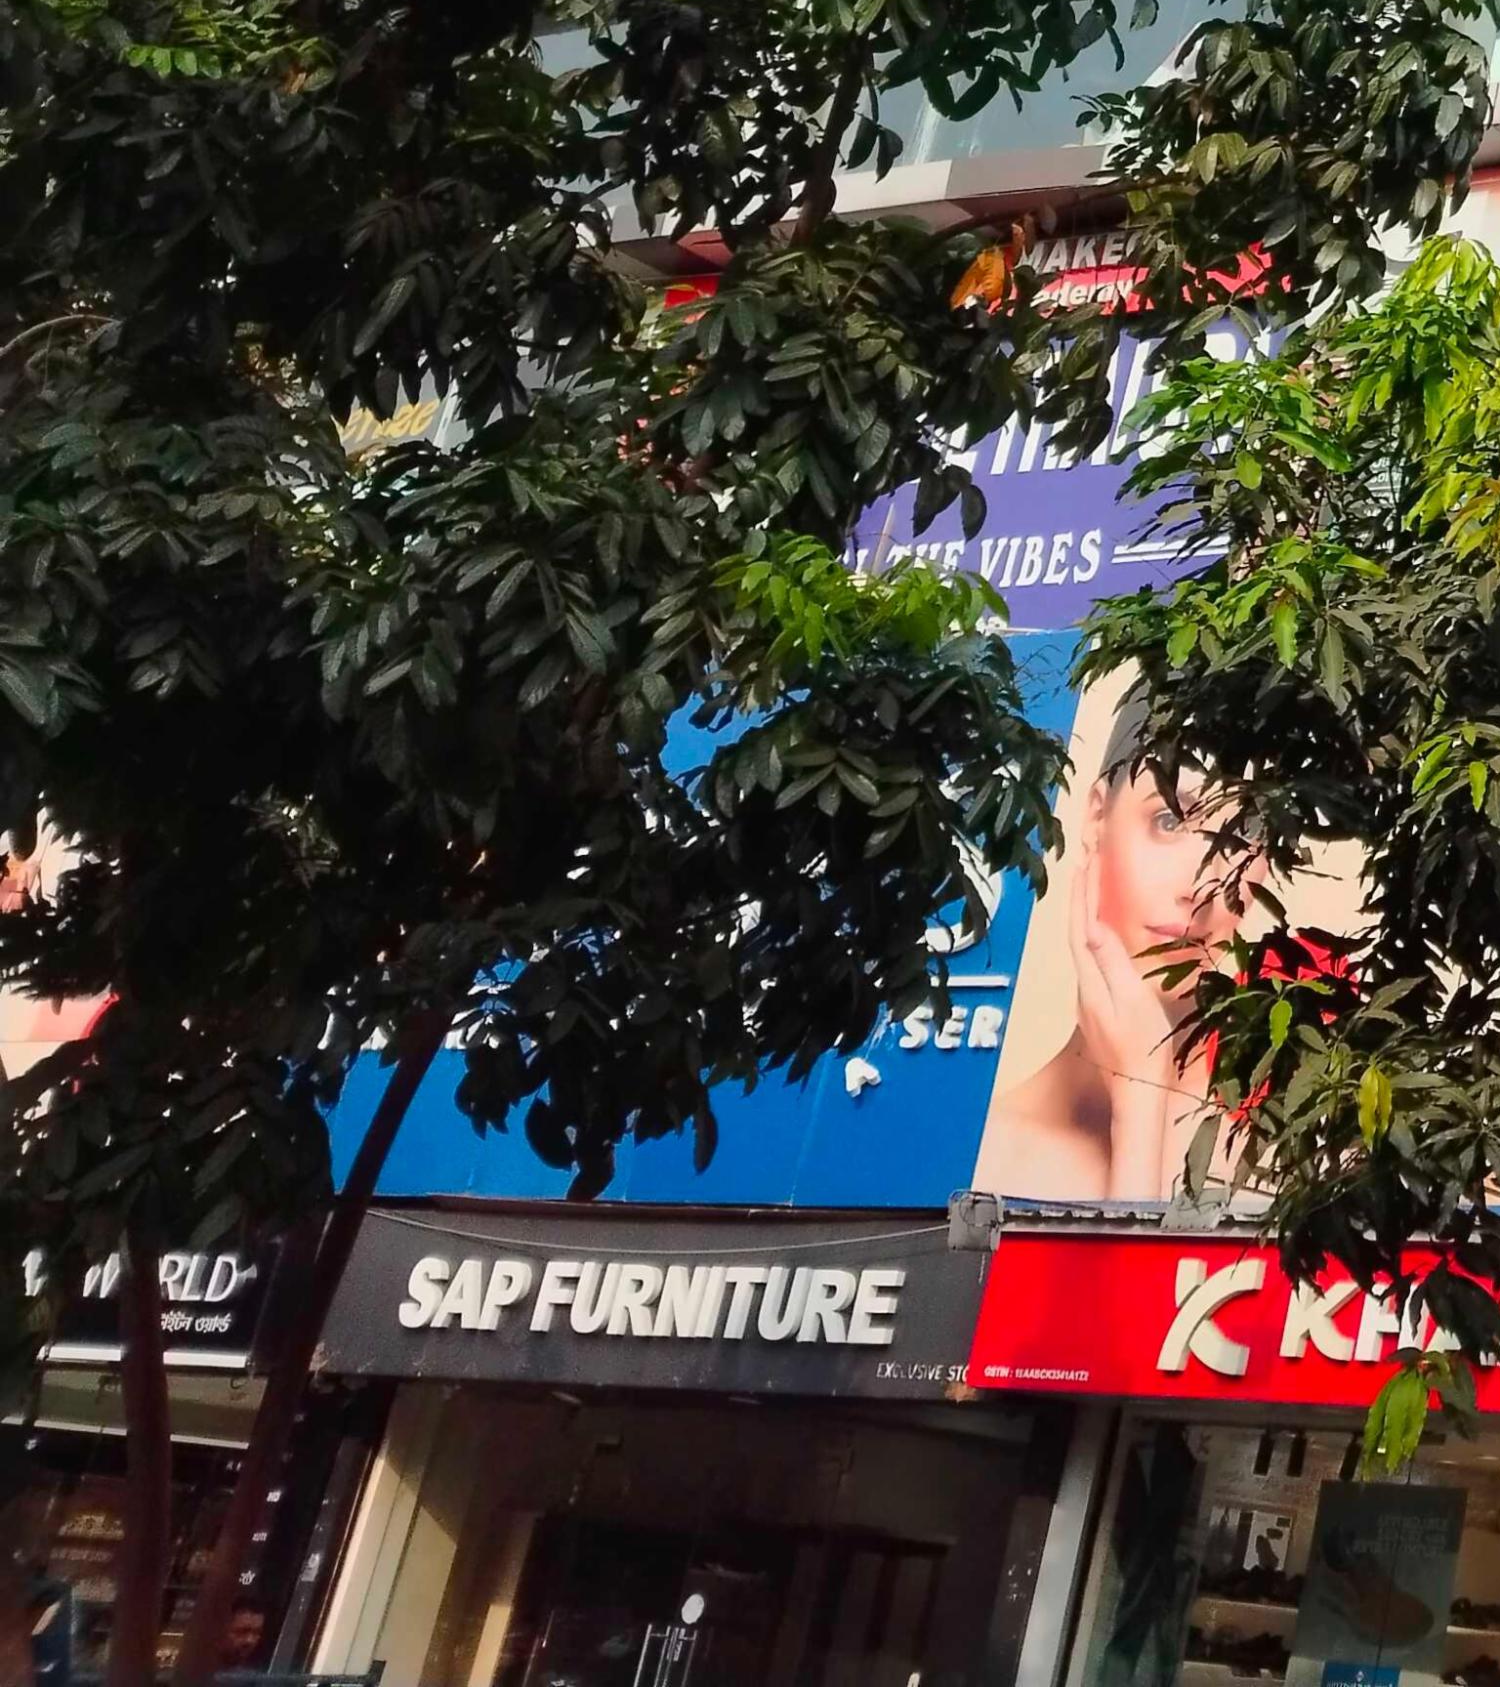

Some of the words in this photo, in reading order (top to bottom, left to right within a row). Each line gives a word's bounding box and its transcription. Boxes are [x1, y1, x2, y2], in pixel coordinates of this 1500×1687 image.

[979, 527, 1102, 589] VIBES
[400, 1256, 524, 1334] SAP
[528, 1258, 906, 1348] FURNITURE
